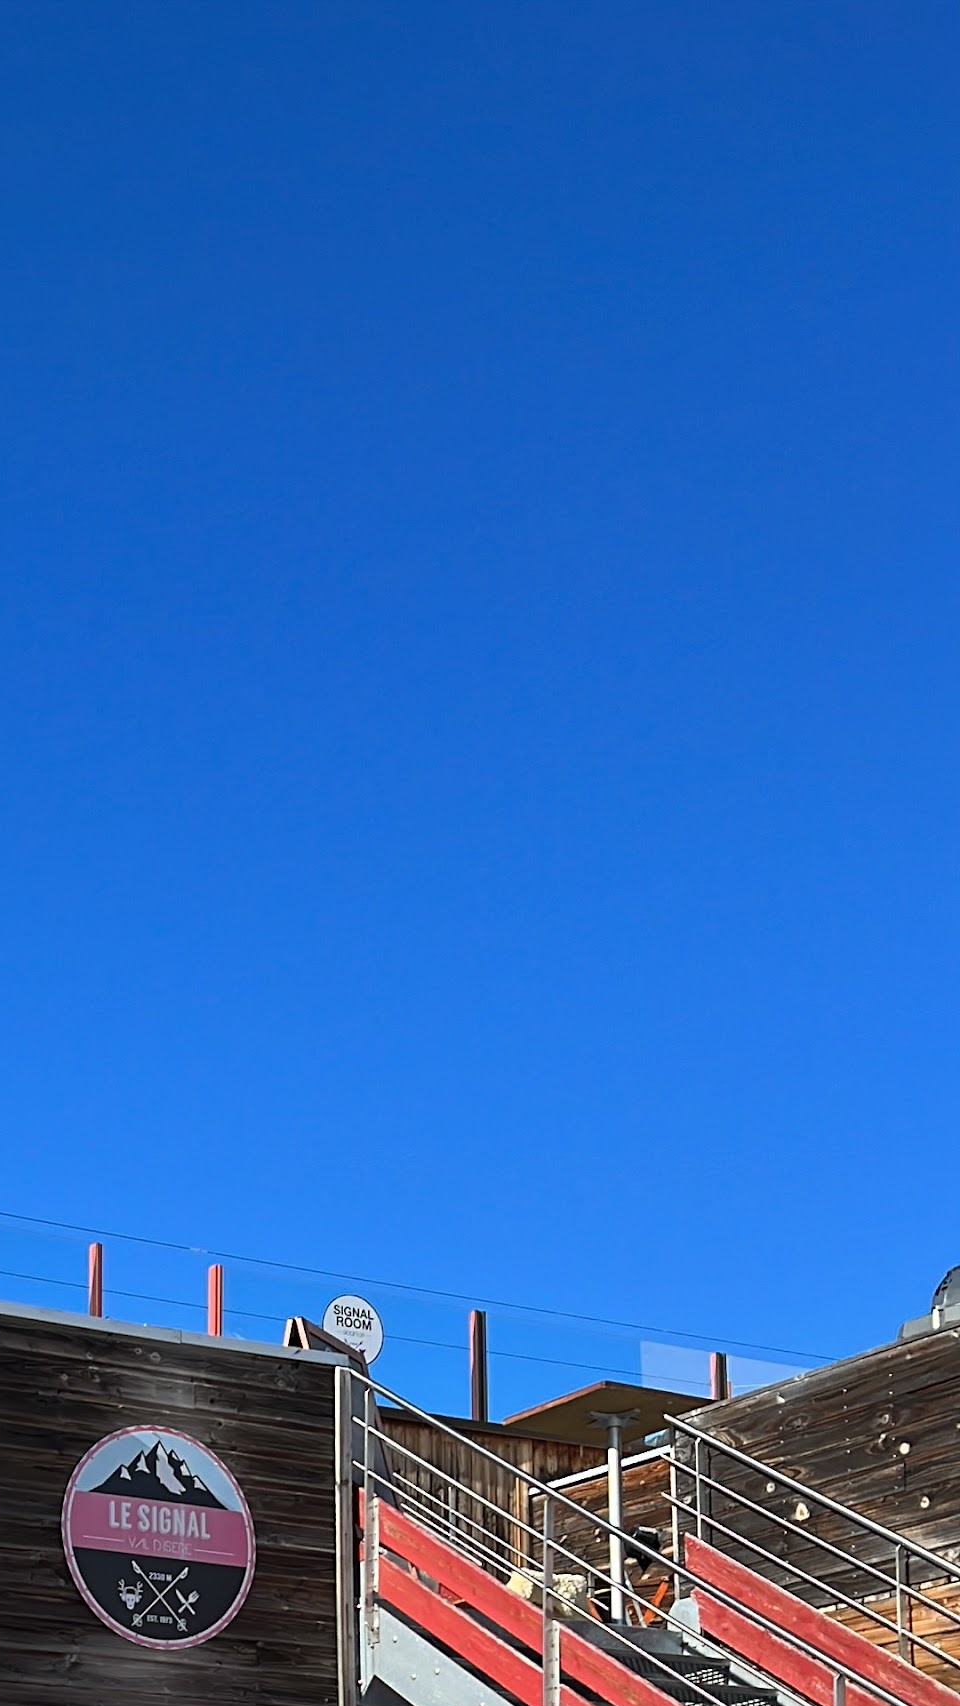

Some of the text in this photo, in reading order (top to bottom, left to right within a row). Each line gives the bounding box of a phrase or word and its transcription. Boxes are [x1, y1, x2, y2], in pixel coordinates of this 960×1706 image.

[333, 1304, 374, 1320] SIGNAL
[336, 1316, 372, 1331] ROOM
[109, 1500, 211, 1540] LE SIGNAL
